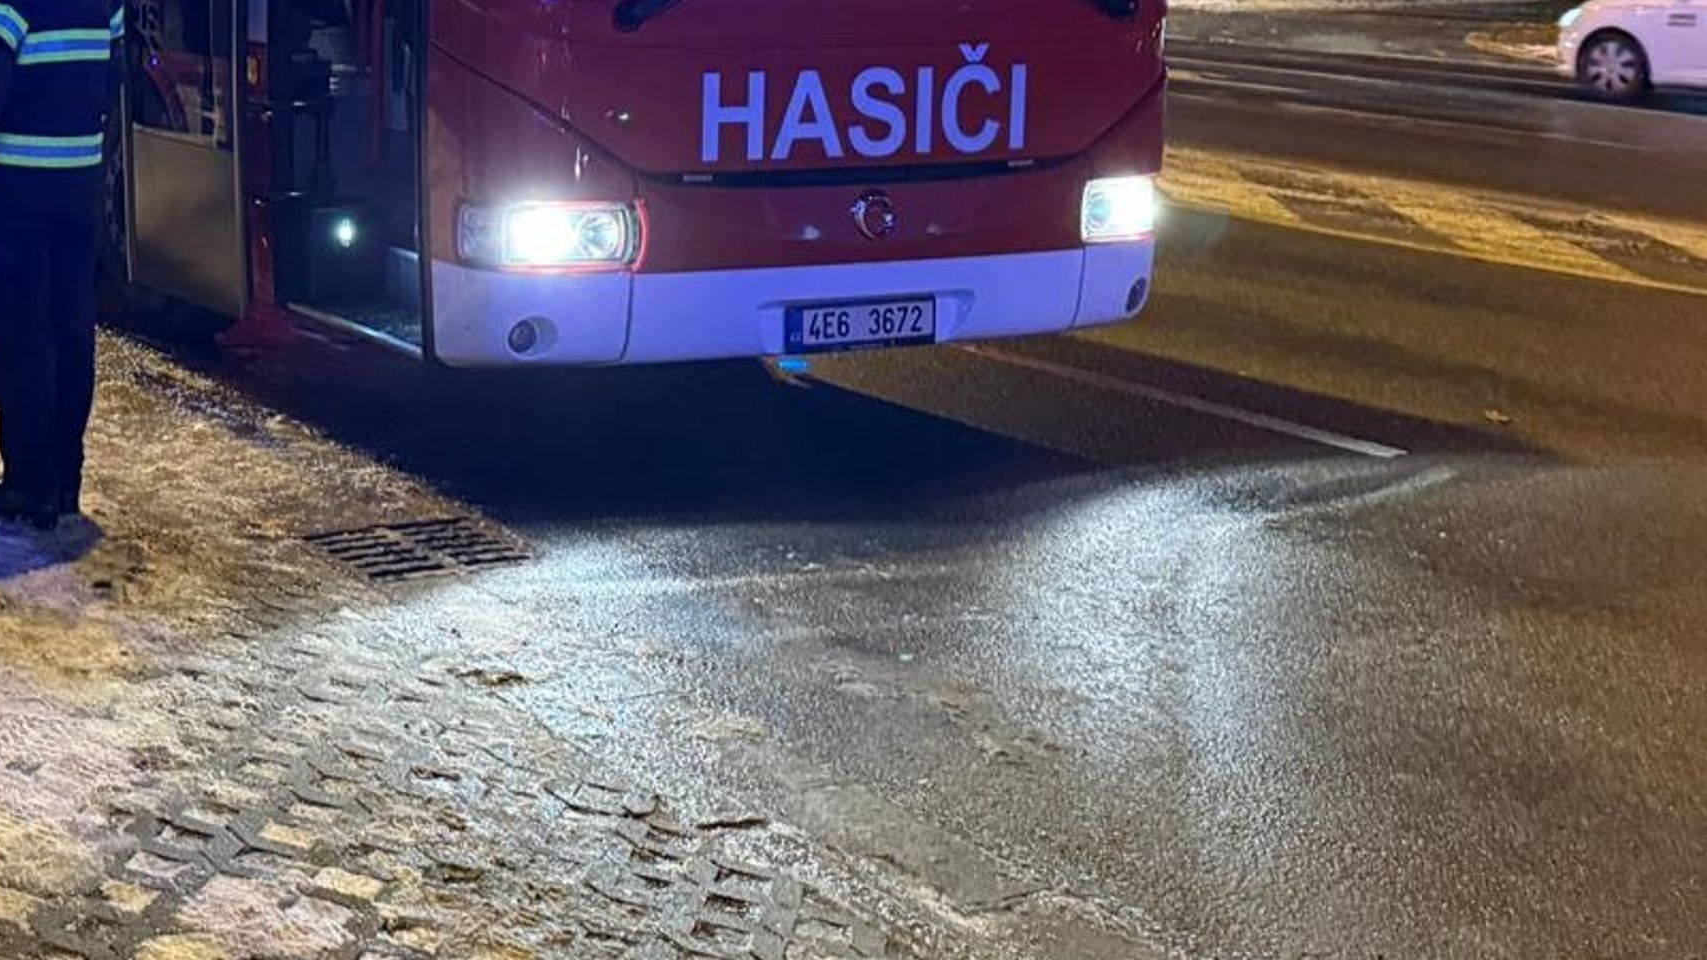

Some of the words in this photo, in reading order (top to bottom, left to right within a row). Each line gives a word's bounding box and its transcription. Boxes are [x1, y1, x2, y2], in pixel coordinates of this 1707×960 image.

[701, 41, 1027, 162] HASIČI
[809, 310, 851, 340] 4E6
[869, 305, 923, 335] 3672
